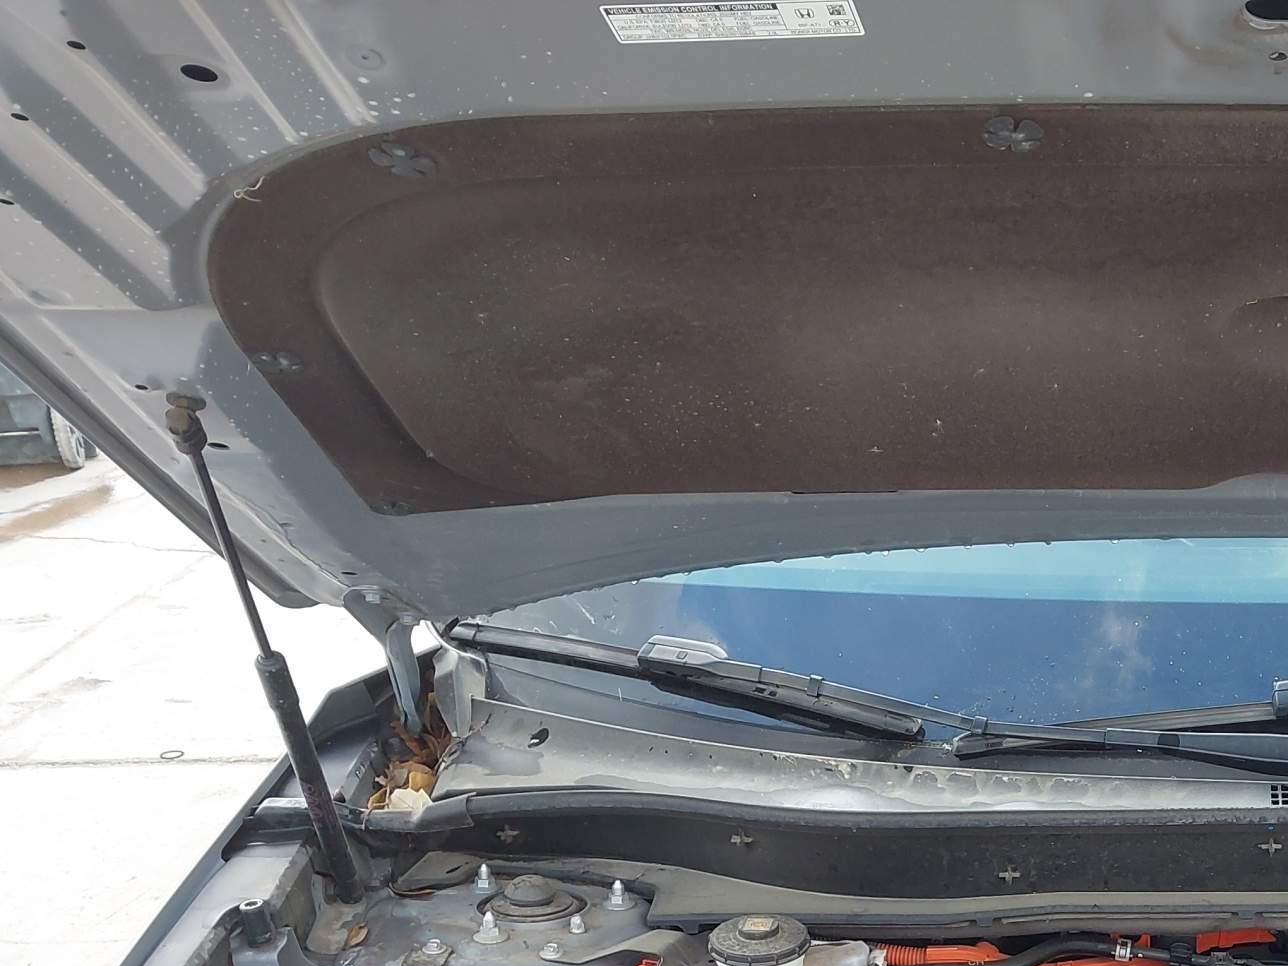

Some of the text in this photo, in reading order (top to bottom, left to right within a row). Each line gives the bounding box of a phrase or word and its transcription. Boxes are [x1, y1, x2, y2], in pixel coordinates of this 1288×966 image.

[643, 6, 681, 14] EMISSION
[682, 5, 719, 13] CONTROL
[720, 3, 774, 11] INFORMATION
